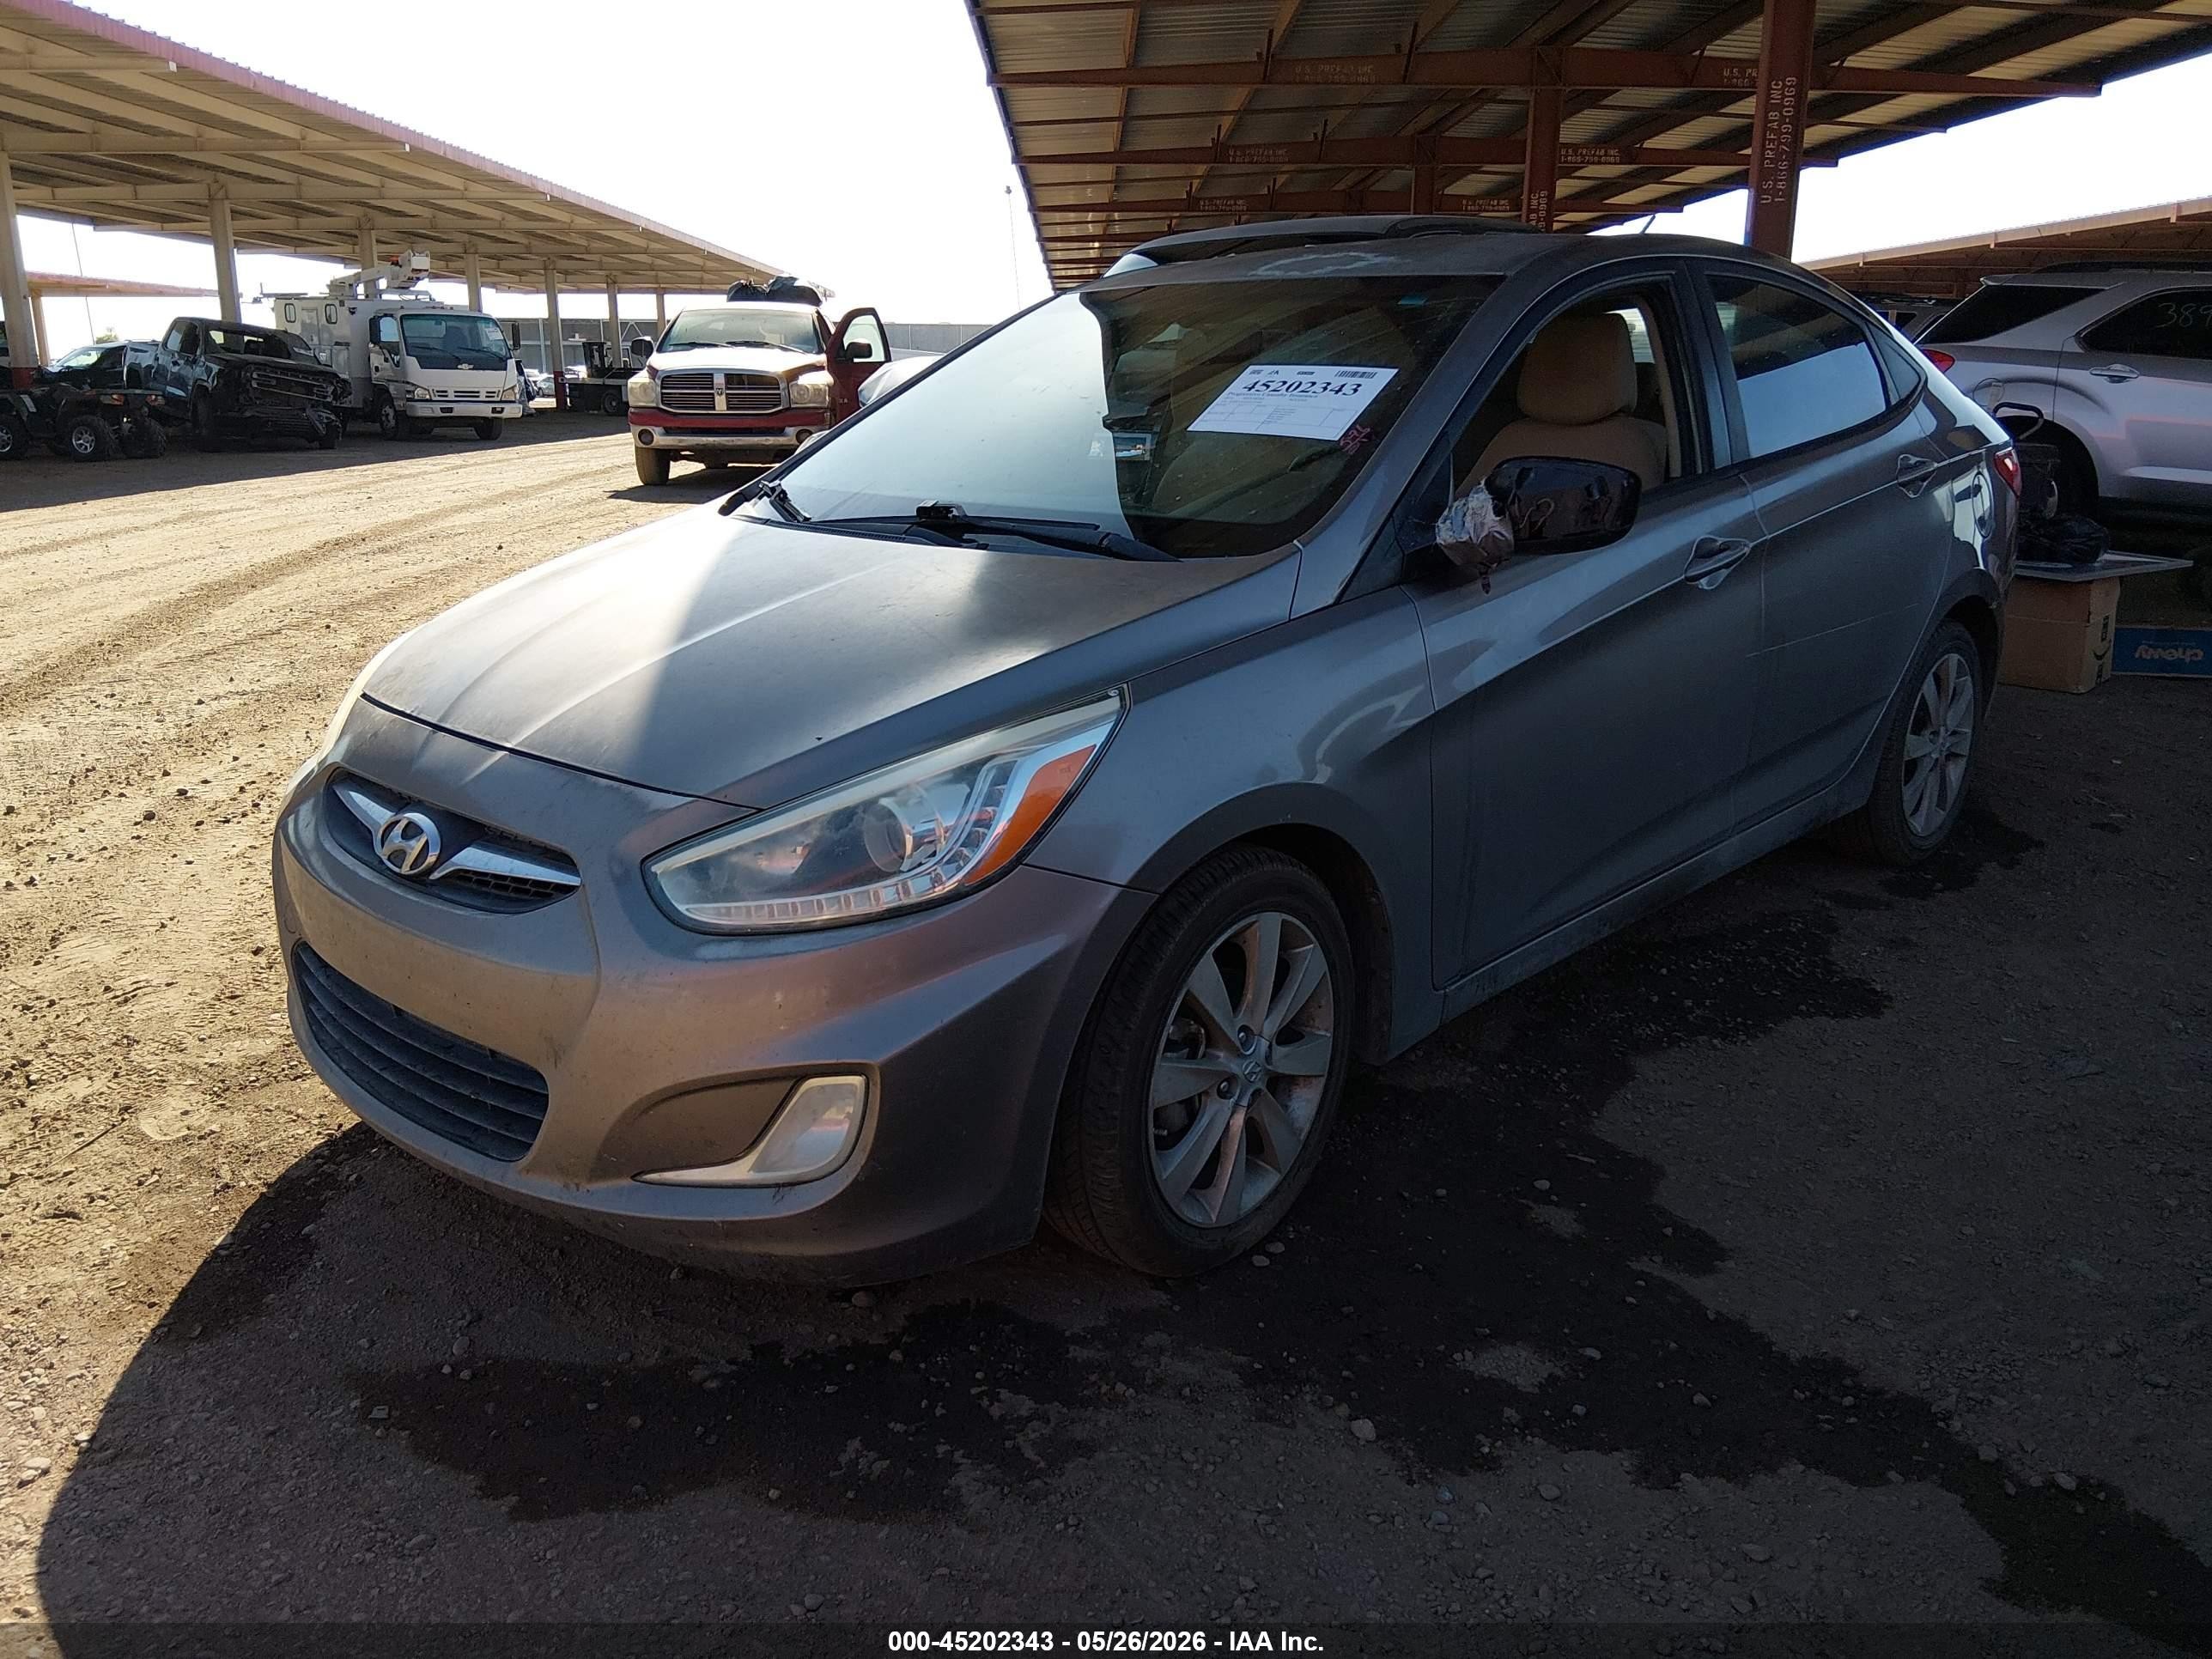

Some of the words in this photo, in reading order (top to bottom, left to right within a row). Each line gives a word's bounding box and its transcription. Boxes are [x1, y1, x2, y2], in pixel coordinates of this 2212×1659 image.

[1764, 111, 1780, 168] PREFAB
[1774, 76, 1797, 203] 1-866-799-0969
[1761, 176, 1774, 204] U.S.
[1243, 380, 1363, 396] 45202343
